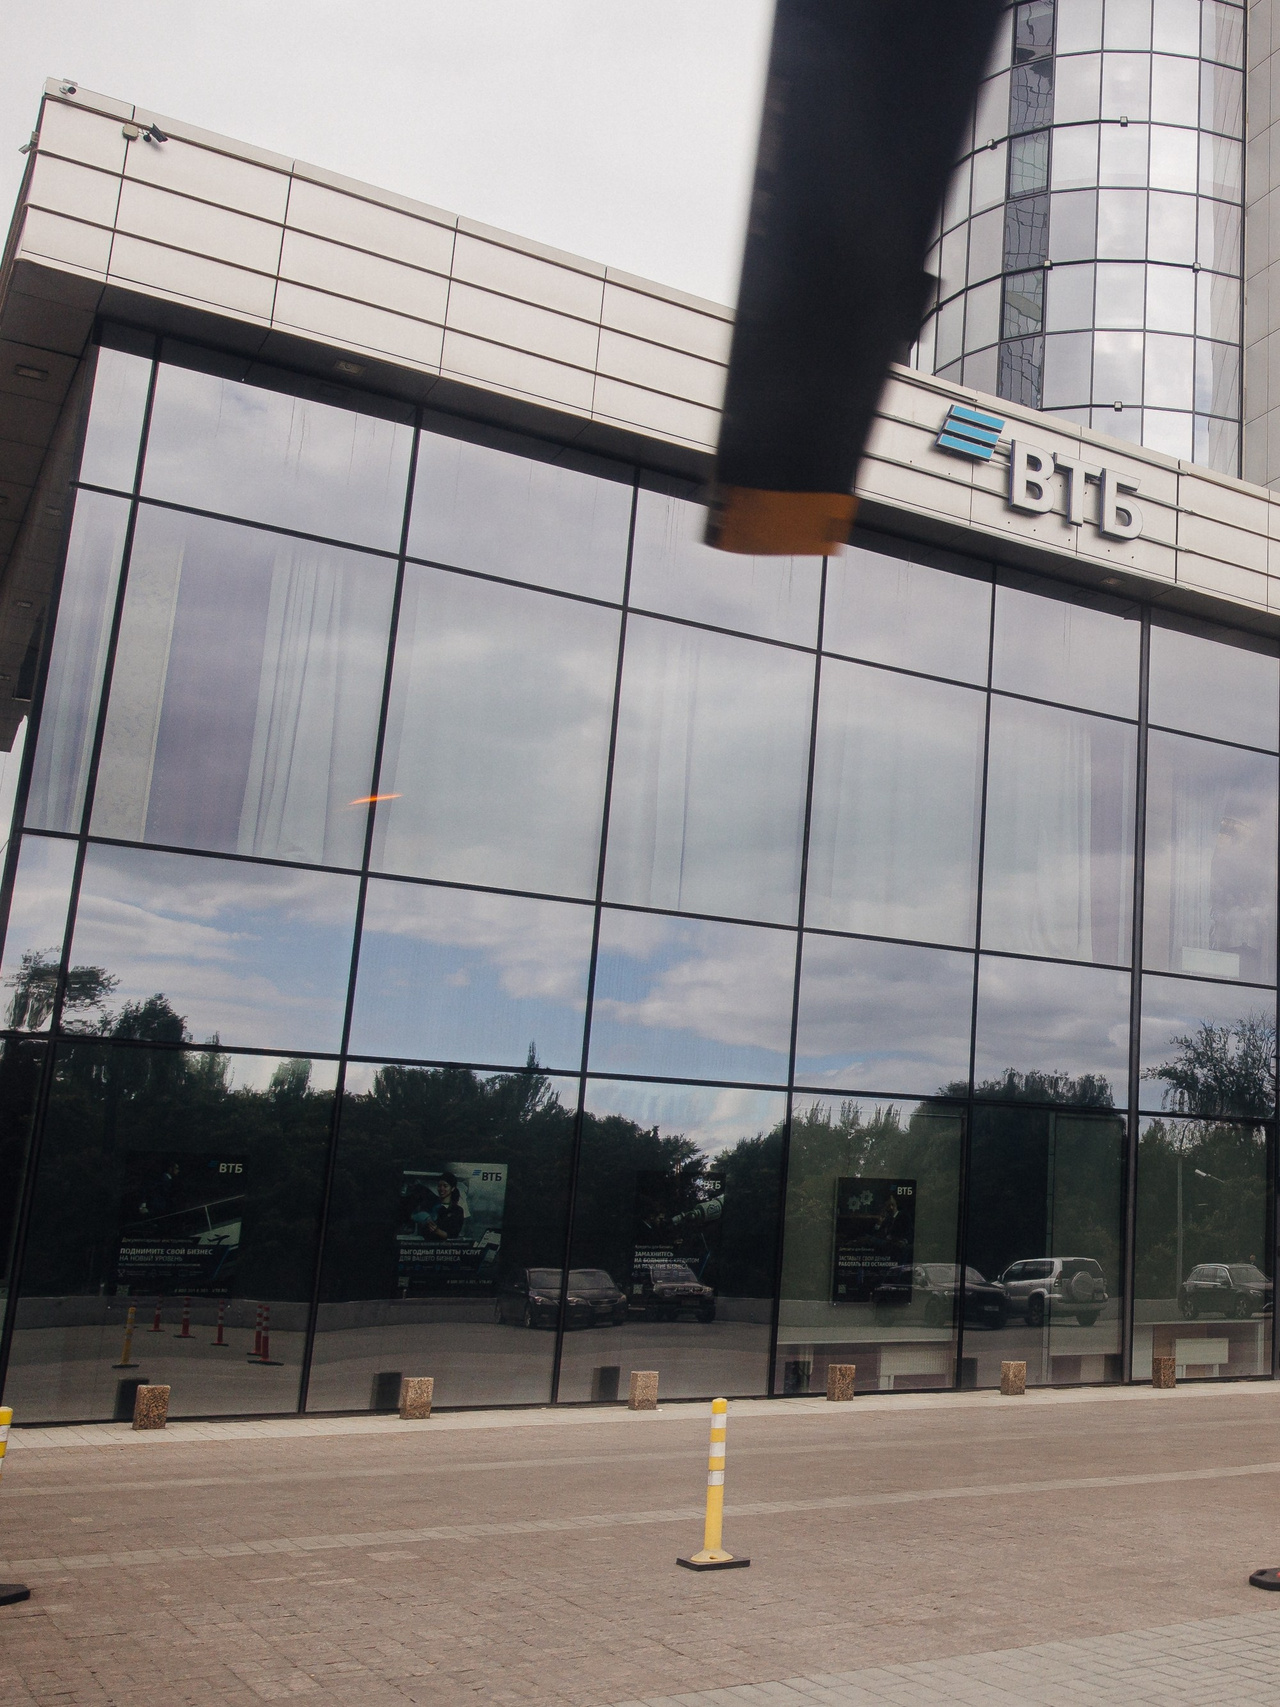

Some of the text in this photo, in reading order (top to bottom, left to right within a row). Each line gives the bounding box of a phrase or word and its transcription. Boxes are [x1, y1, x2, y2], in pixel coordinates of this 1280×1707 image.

[1008, 438, 1143, 541] ВТБ
[218, 1163, 243, 1174] ВТБ
[481, 1171, 502, 1182] ВТБ
[703, 1180, 722, 1190] ВТБ
[896, 1186, 913, 1196] ВТБ
[119, 1247, 214, 1256] ПОДНИМИТЕ СВОЙ БИЗНЕС
[399, 1248, 435, 1256] ВЫГОДНЫЕ
